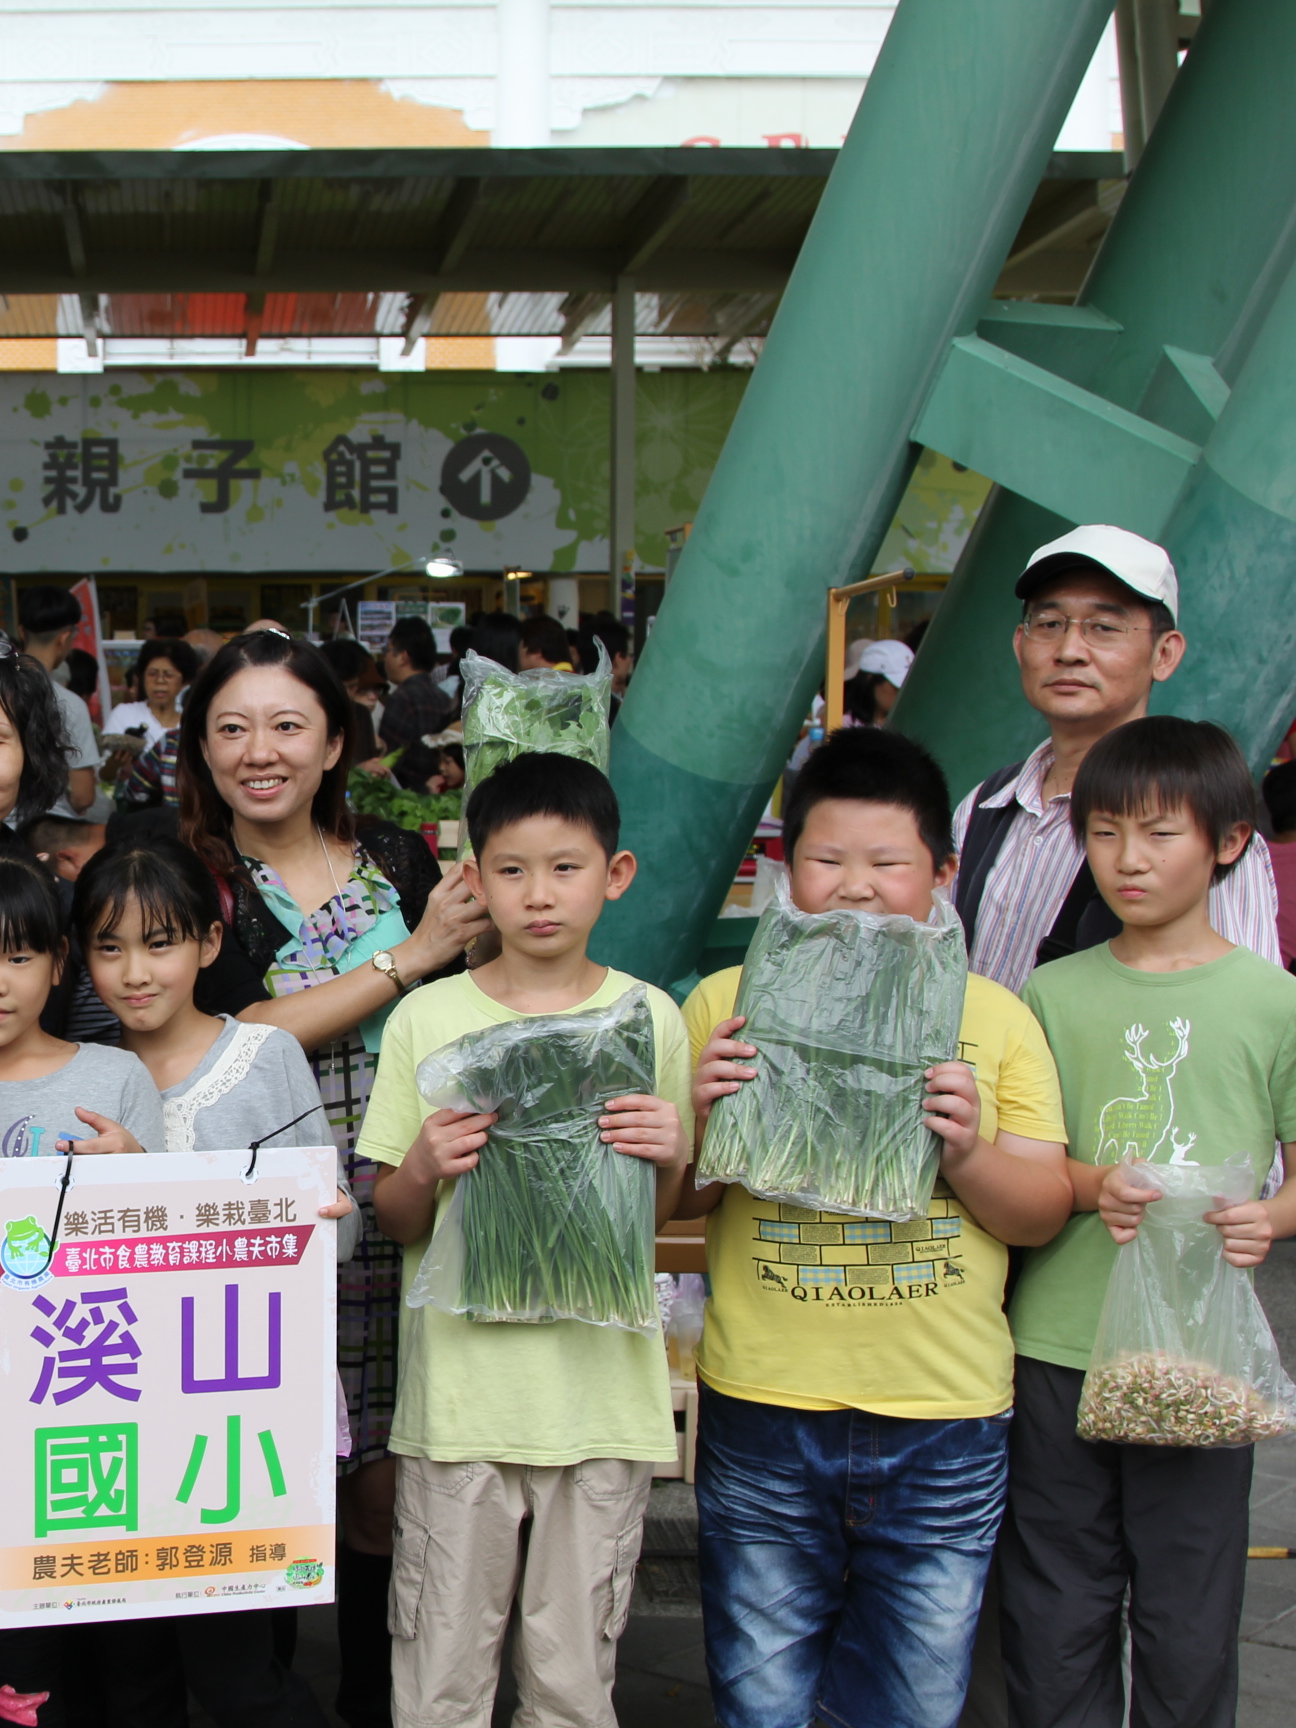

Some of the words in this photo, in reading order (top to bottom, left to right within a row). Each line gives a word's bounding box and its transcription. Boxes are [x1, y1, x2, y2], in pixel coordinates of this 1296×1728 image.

[65, 1233, 298, 1273] 臺北市食農教育課程小農夫市集
[791, 1282, 939, 1303] QIAOLAER
[249, 1543, 287, 1564] 指導
